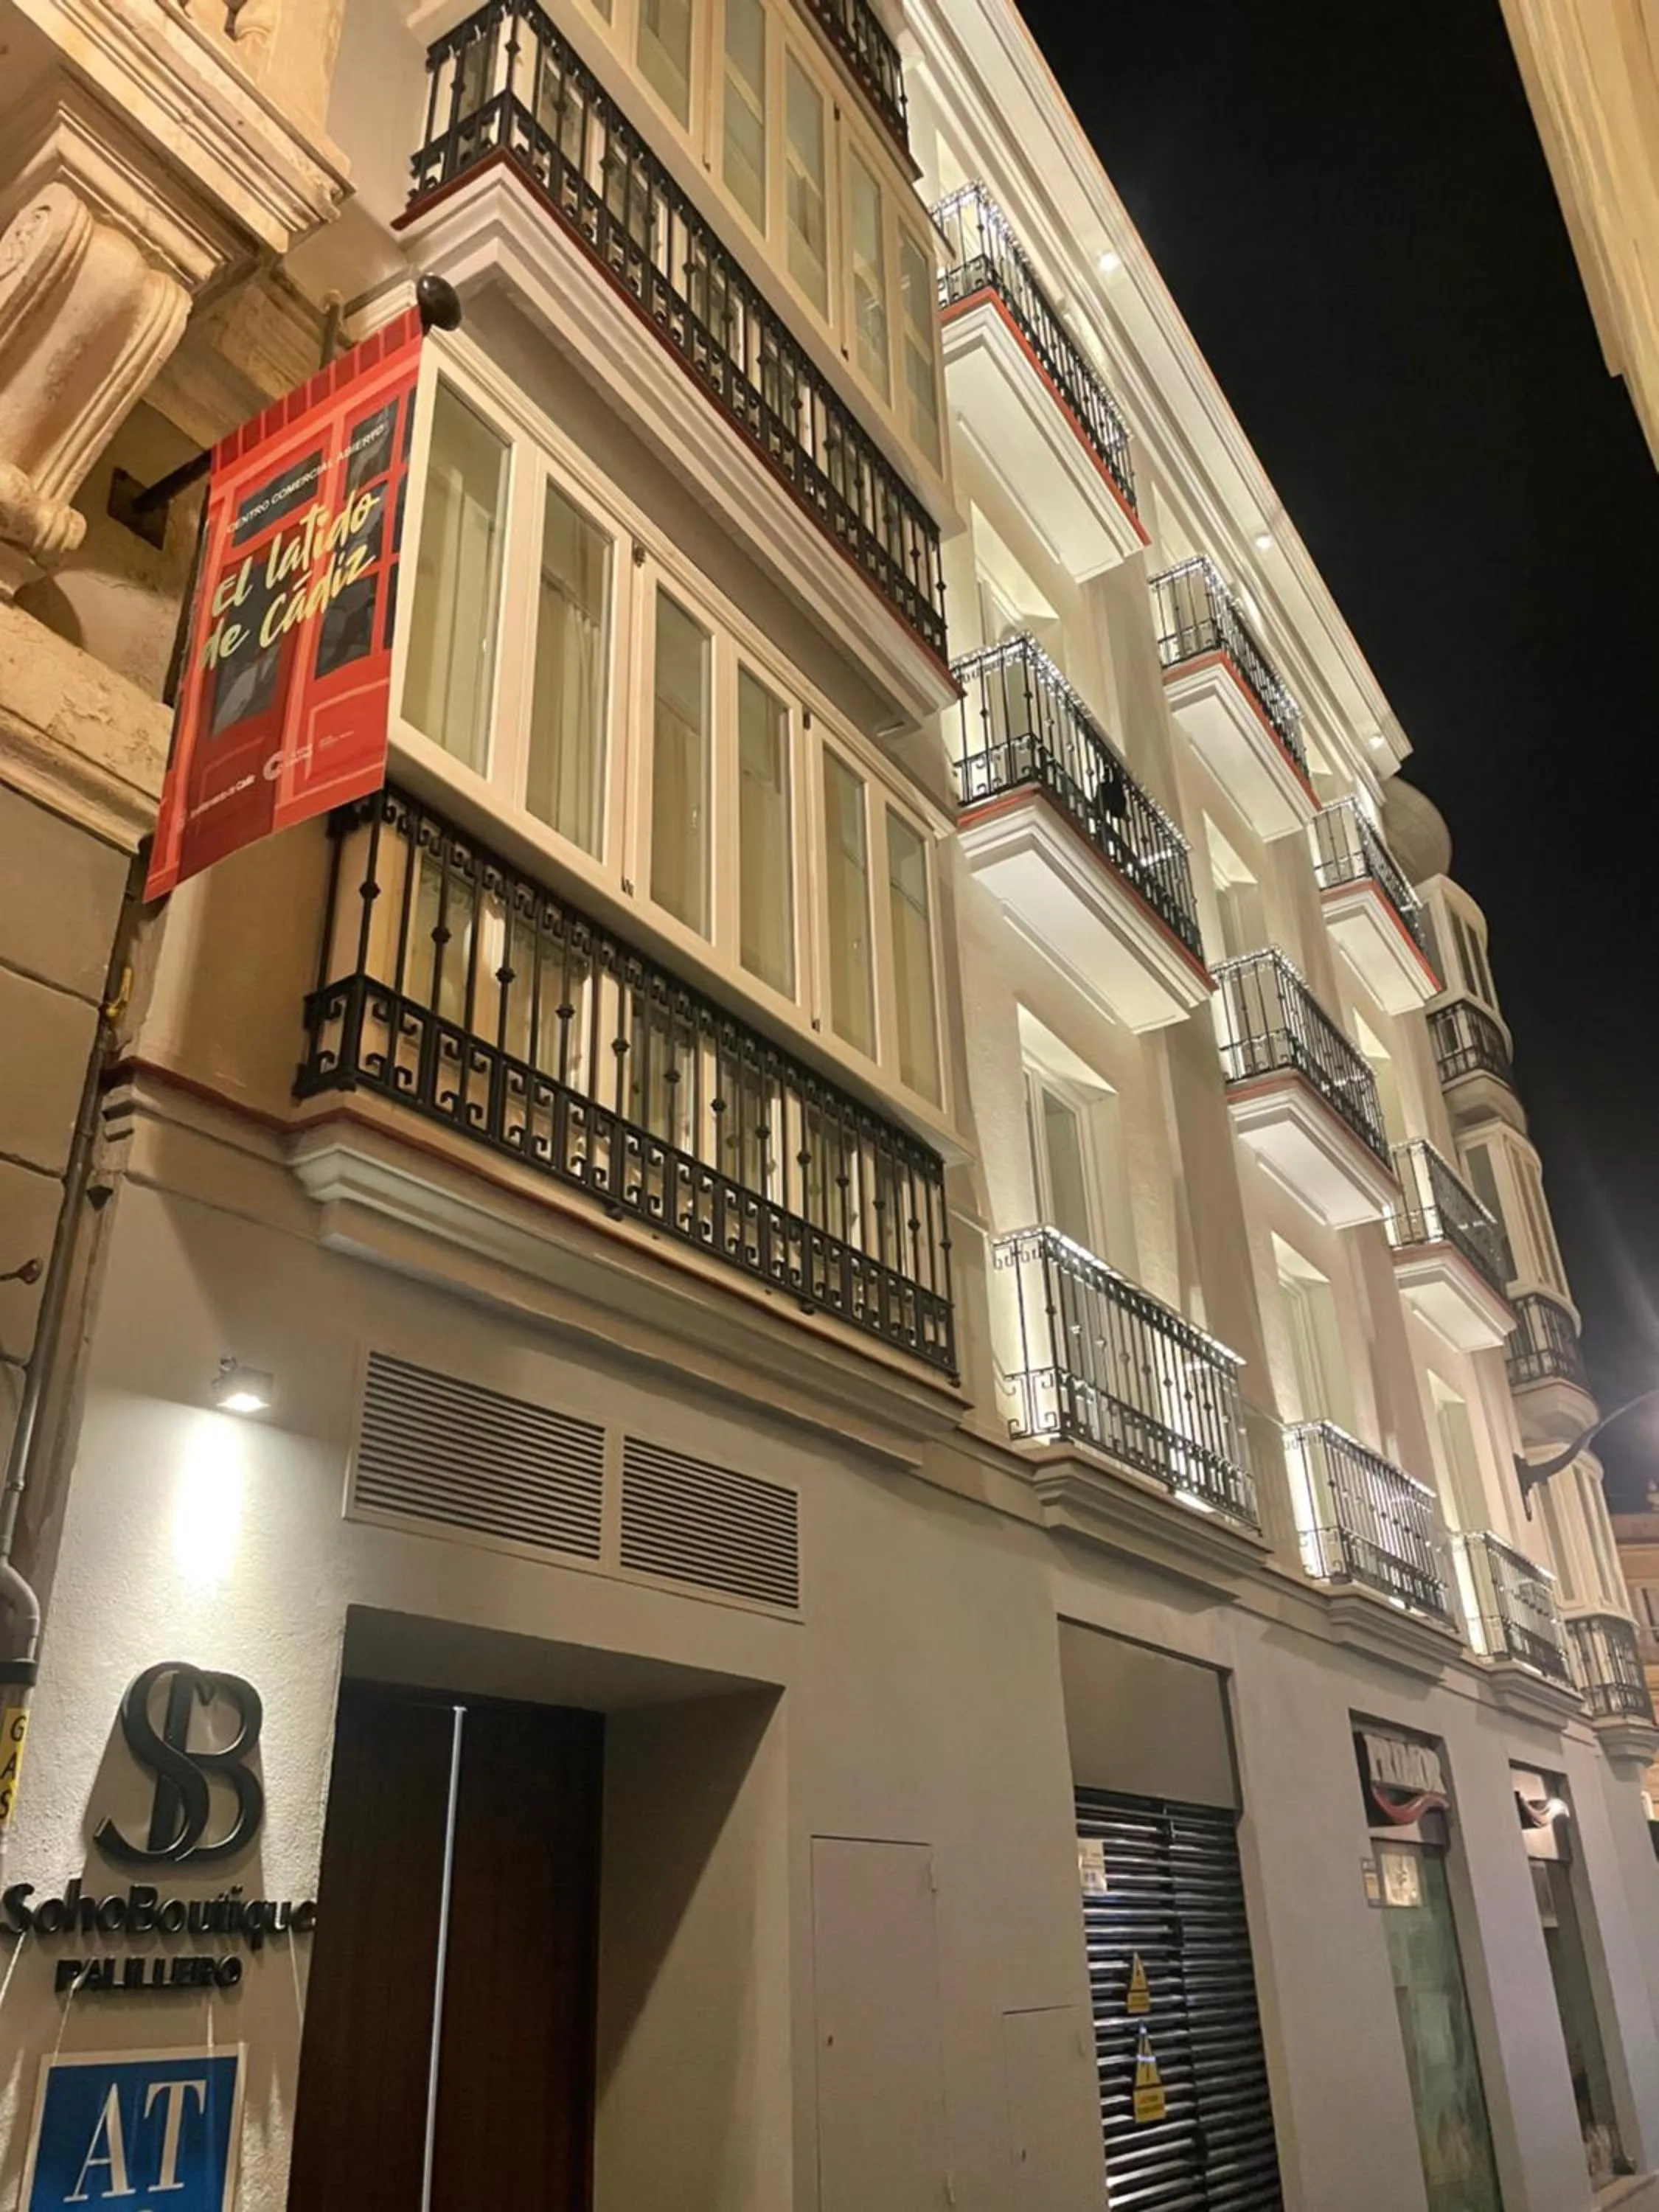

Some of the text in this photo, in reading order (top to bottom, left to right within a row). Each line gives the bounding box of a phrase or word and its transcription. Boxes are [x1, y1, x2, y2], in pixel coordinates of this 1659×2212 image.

[212, 489, 381, 617] El latido
[226, 498, 271, 532] CENTRO
[271, 459, 333, 505] COMERCIAL
[200, 543, 377, 670] de Cádiz
[0, 1714, 27, 1820] GAS
[63, 2079, 207, 2203] AT
